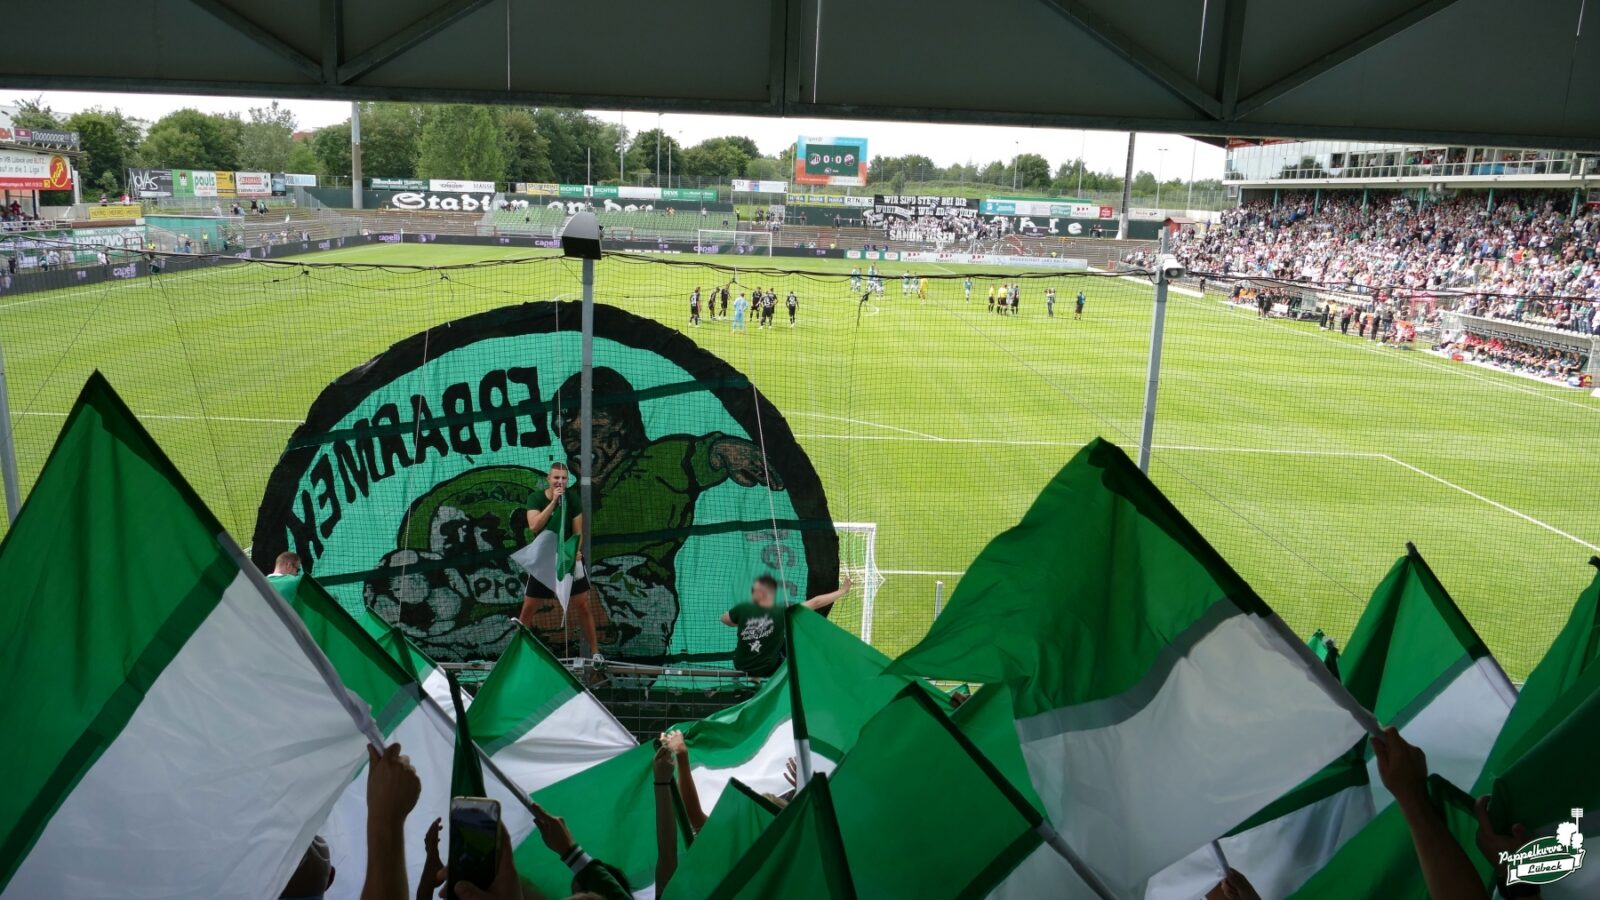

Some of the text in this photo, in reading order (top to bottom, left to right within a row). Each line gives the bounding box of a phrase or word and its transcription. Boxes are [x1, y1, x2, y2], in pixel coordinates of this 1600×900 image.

[823, 154, 830, 163] 0
[835, 155, 842, 164] 0
[883, 195, 899, 204] WIR
[535, 239, 561, 249] capelli
